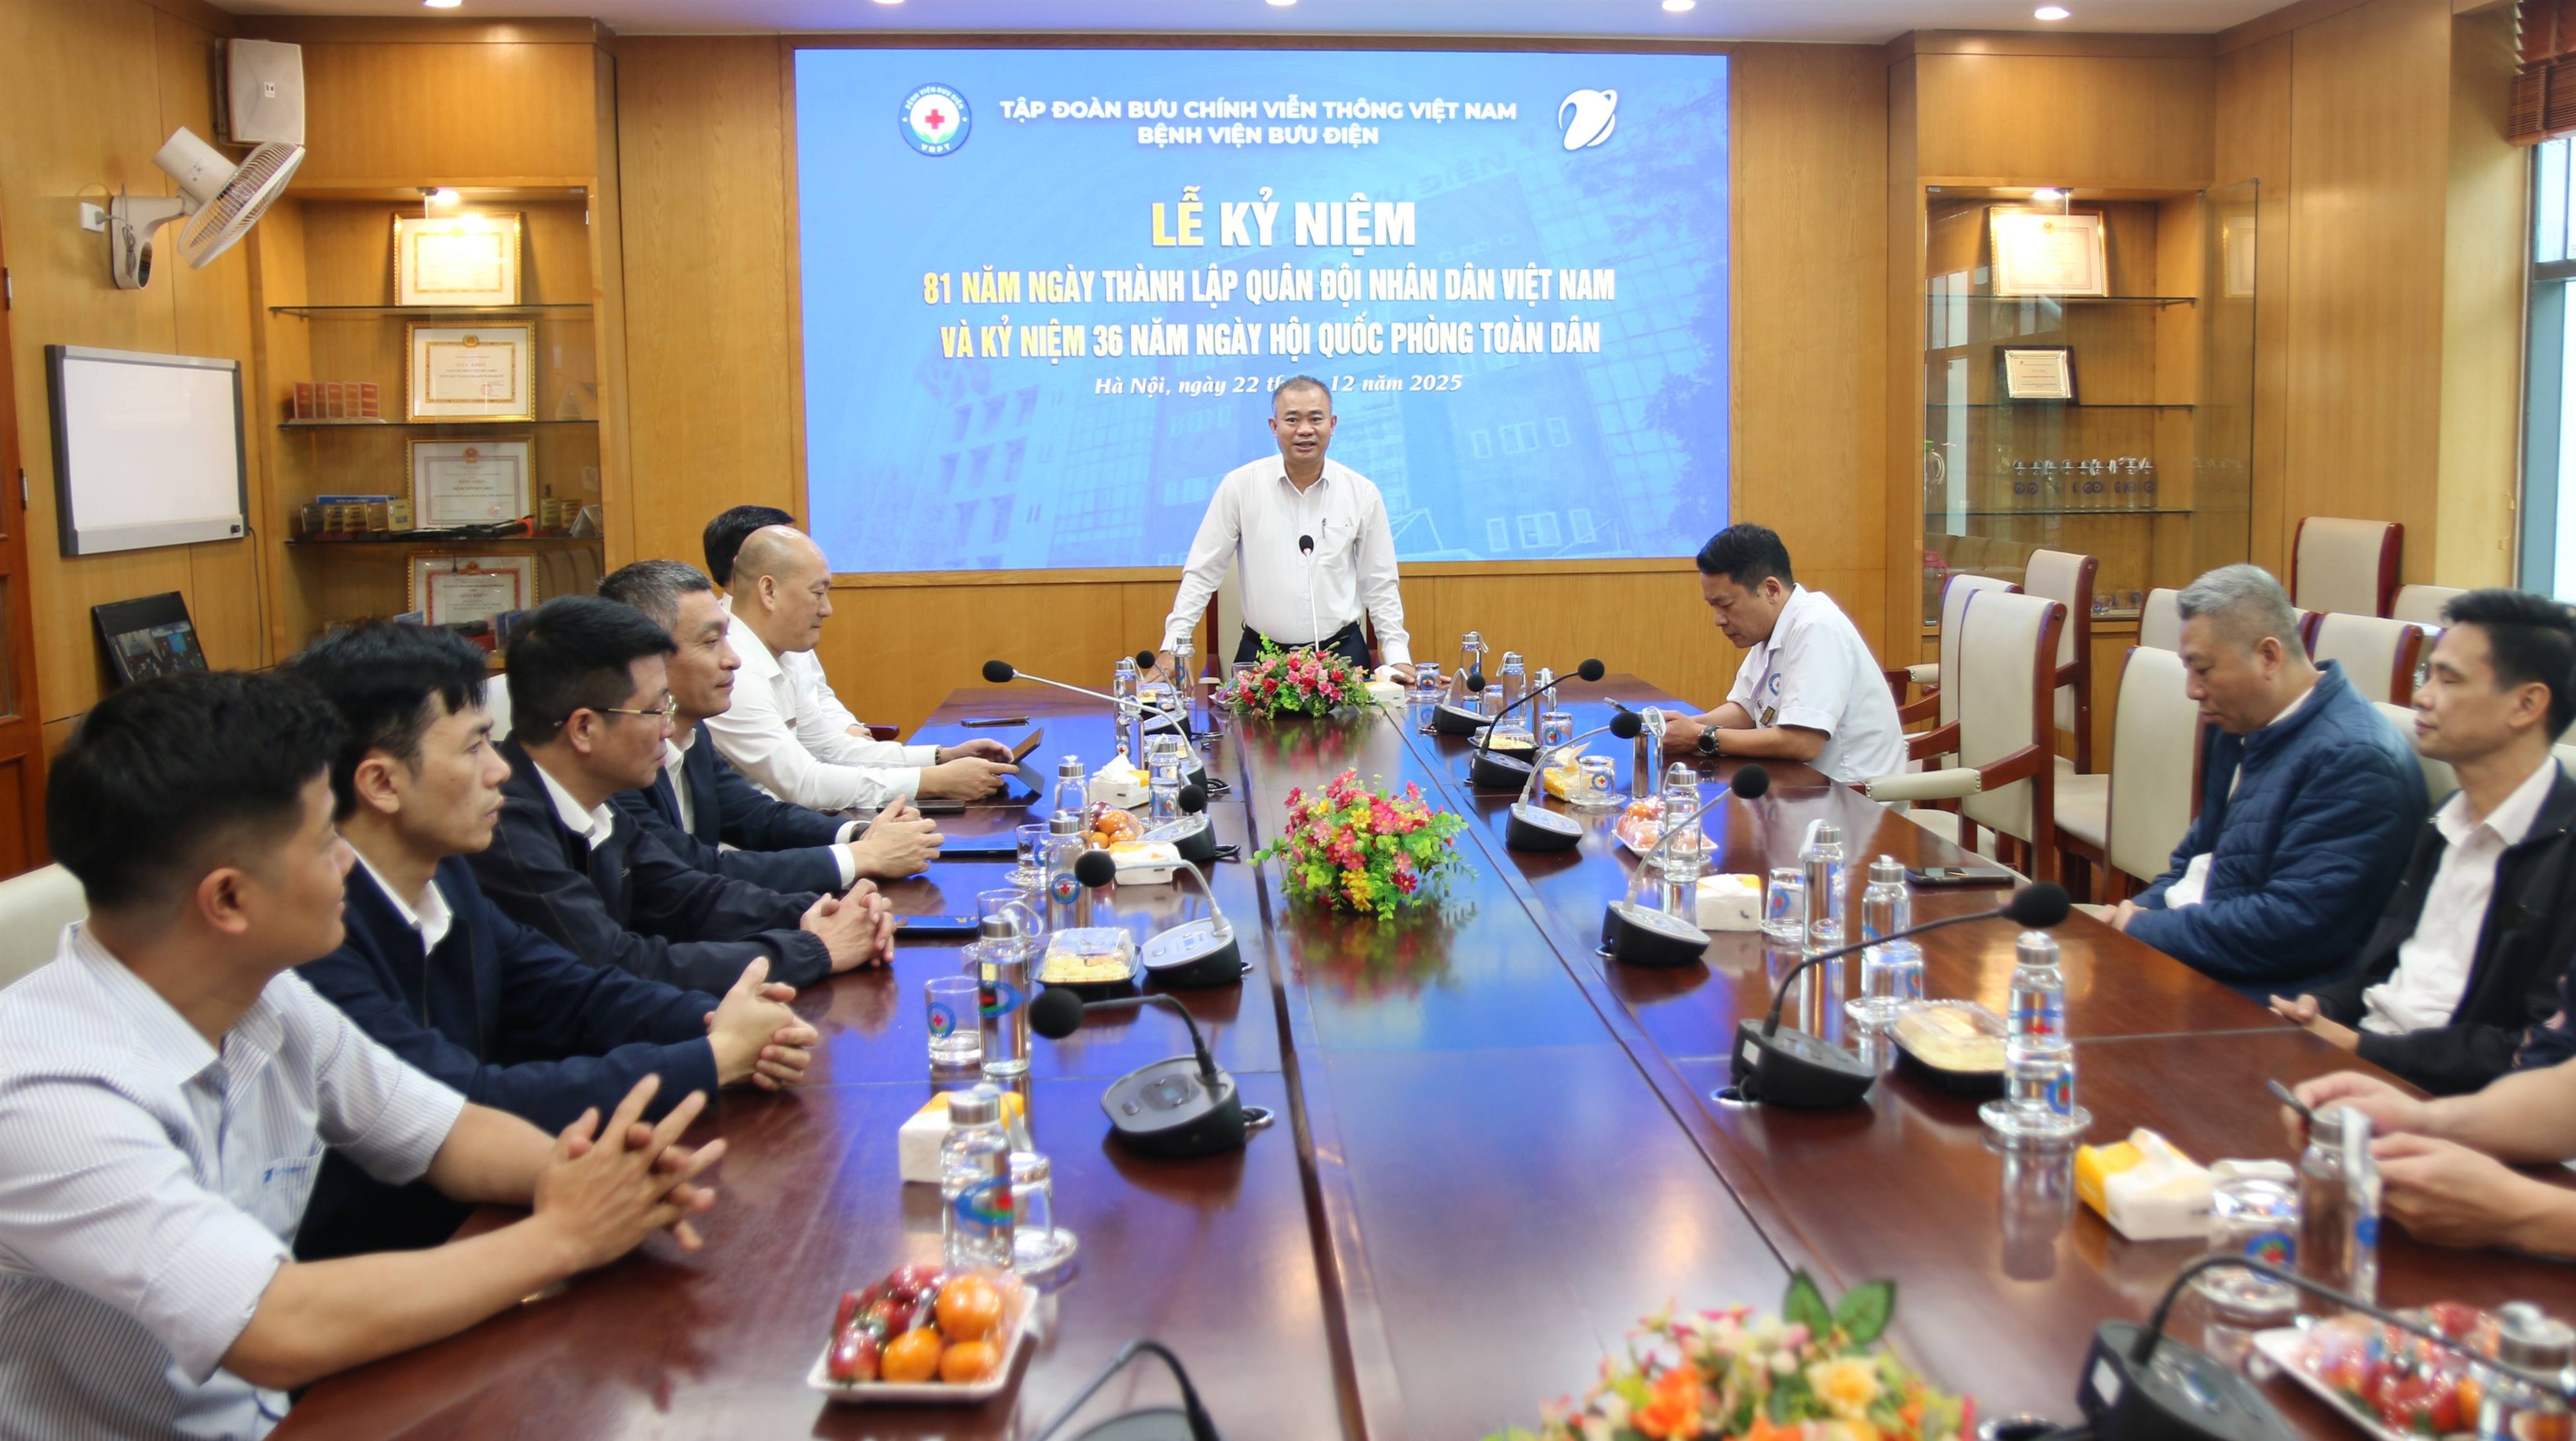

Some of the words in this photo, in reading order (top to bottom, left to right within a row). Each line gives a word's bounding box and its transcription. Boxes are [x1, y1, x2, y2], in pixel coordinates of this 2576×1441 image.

[999, 96, 1046, 123] TẬP
[1051, 97, 1121, 118] ĐOÀN
[1128, 99, 1177, 119] BƯU
[1184, 97, 1257, 118] CHÍNH
[1262, 94, 1317, 118] VIỄN
[1322, 97, 1403, 119] THÔNG
[1408, 97, 1460, 124] VIỆT
[1465, 102, 1517, 119] NAM
[1138, 122, 1202, 148] BỆNH
[1207, 122, 1262, 148] VIỆN
[1268, 124, 1318, 144] BƯU
[1323, 123, 1379, 148] ĐIỆN
[1152, 185, 1204, 246] LỄ
[1221, 186, 1280, 246] KỶ
[1295, 192, 1416, 256] NIỆM
[923, 272, 951, 304] 81
[962, 264, 1021, 304] NĂM
[1028, 263, 1096, 303] NGÀY
[1102, 263, 1185, 302] THÀNH
[1192, 262, 1238, 309] LẬP
[1246, 262, 1314, 305] QUÂN
[1319, 262, 1362, 308] ĐỘI
[1368, 262, 1438, 301] NHÂN
[1445, 262, 1496, 301] DÂN
[1501, 262, 1553, 307] VIỆT
[1559, 268, 1615, 301] NAM
[940, 319, 974, 358] VÀ
[980, 314, 1013, 358] KỶ
[1020, 318, 1085, 364] NIỆM
[1093, 324, 1123, 356] 36
[1130, 317, 1189, 356] NĂM
[1196, 316, 1262, 355] NGÀY
[1270, 316, 1311, 362] HỘI
[1318, 311, 1384, 358] QUỐC
[1391, 314, 1474, 354] PHÒNG
[1480, 314, 1544, 353] TOÀN
[1551, 314, 1601, 353] DÂN
[1095, 376, 1123, 394] Hà
[1130, 376, 1170, 398] Nội,
[1178, 375, 1226, 397] ngày
[1232, 376, 1259, 393] 22
[1331, 375, 1355, 392] 12
[1362, 375, 1403, 391] năm
[1409, 374, 1463, 391] 2025
